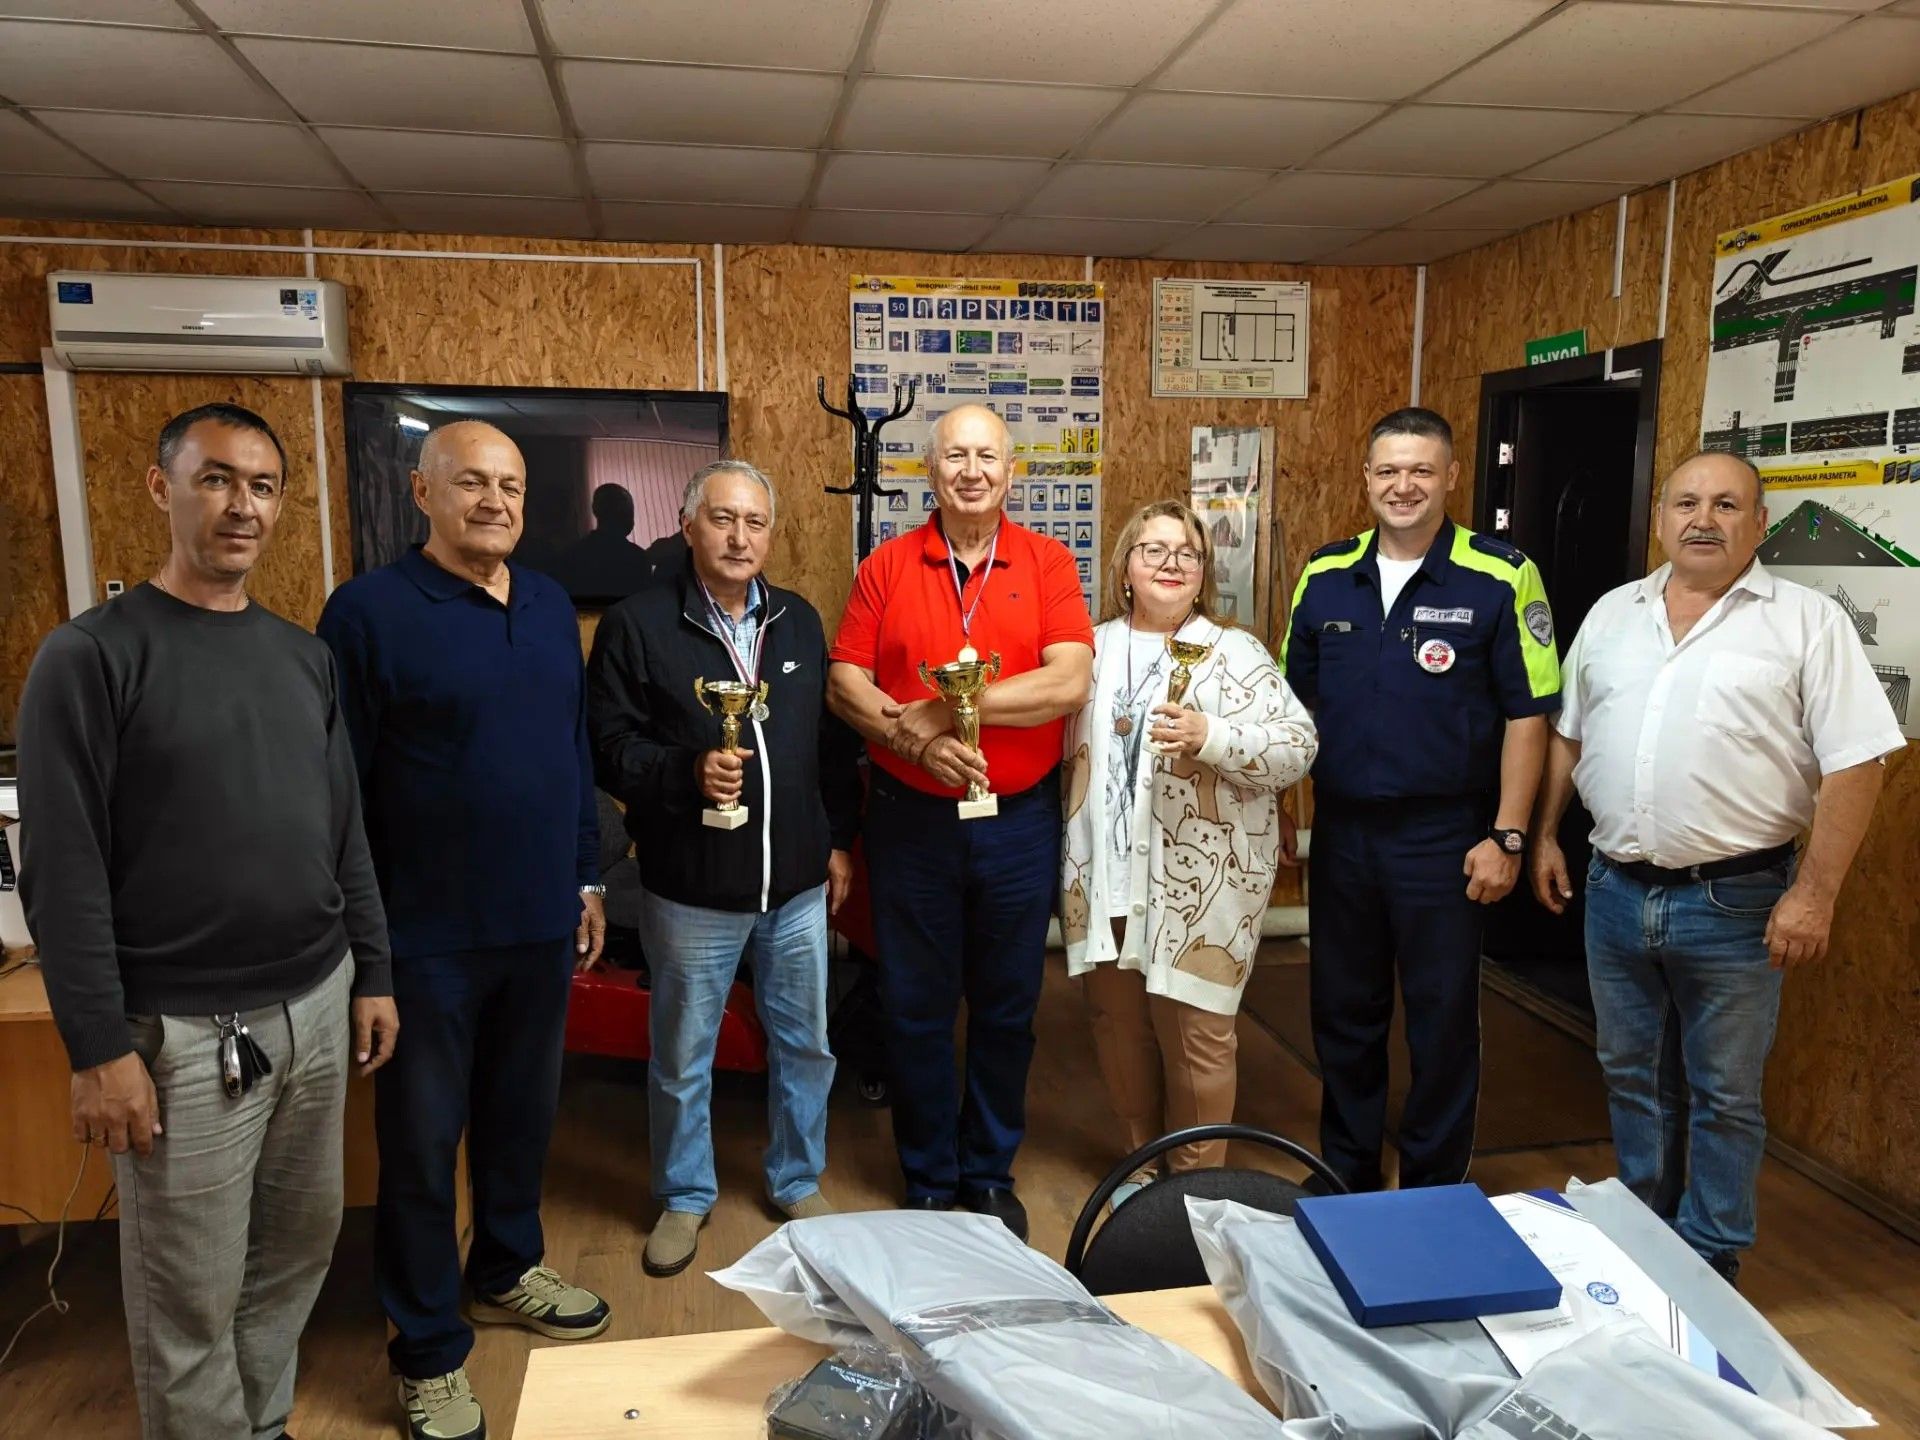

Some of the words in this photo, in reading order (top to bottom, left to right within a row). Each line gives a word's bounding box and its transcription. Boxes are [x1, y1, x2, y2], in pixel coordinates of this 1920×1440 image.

[1780, 206, 1847, 232] ГОРИЗОНТАЛЬНАЯ
[1847, 194, 1889, 214] РАЗМЕТКА
[915, 282, 979, 291] ИНФОРМАЦИОННЫЕ
[892, 302, 906, 312] 50
[1762, 472, 1817, 484] ВЕРТИКАЛЬНАЯ
[1818, 471, 1857, 481] РАЗМЕТКА
